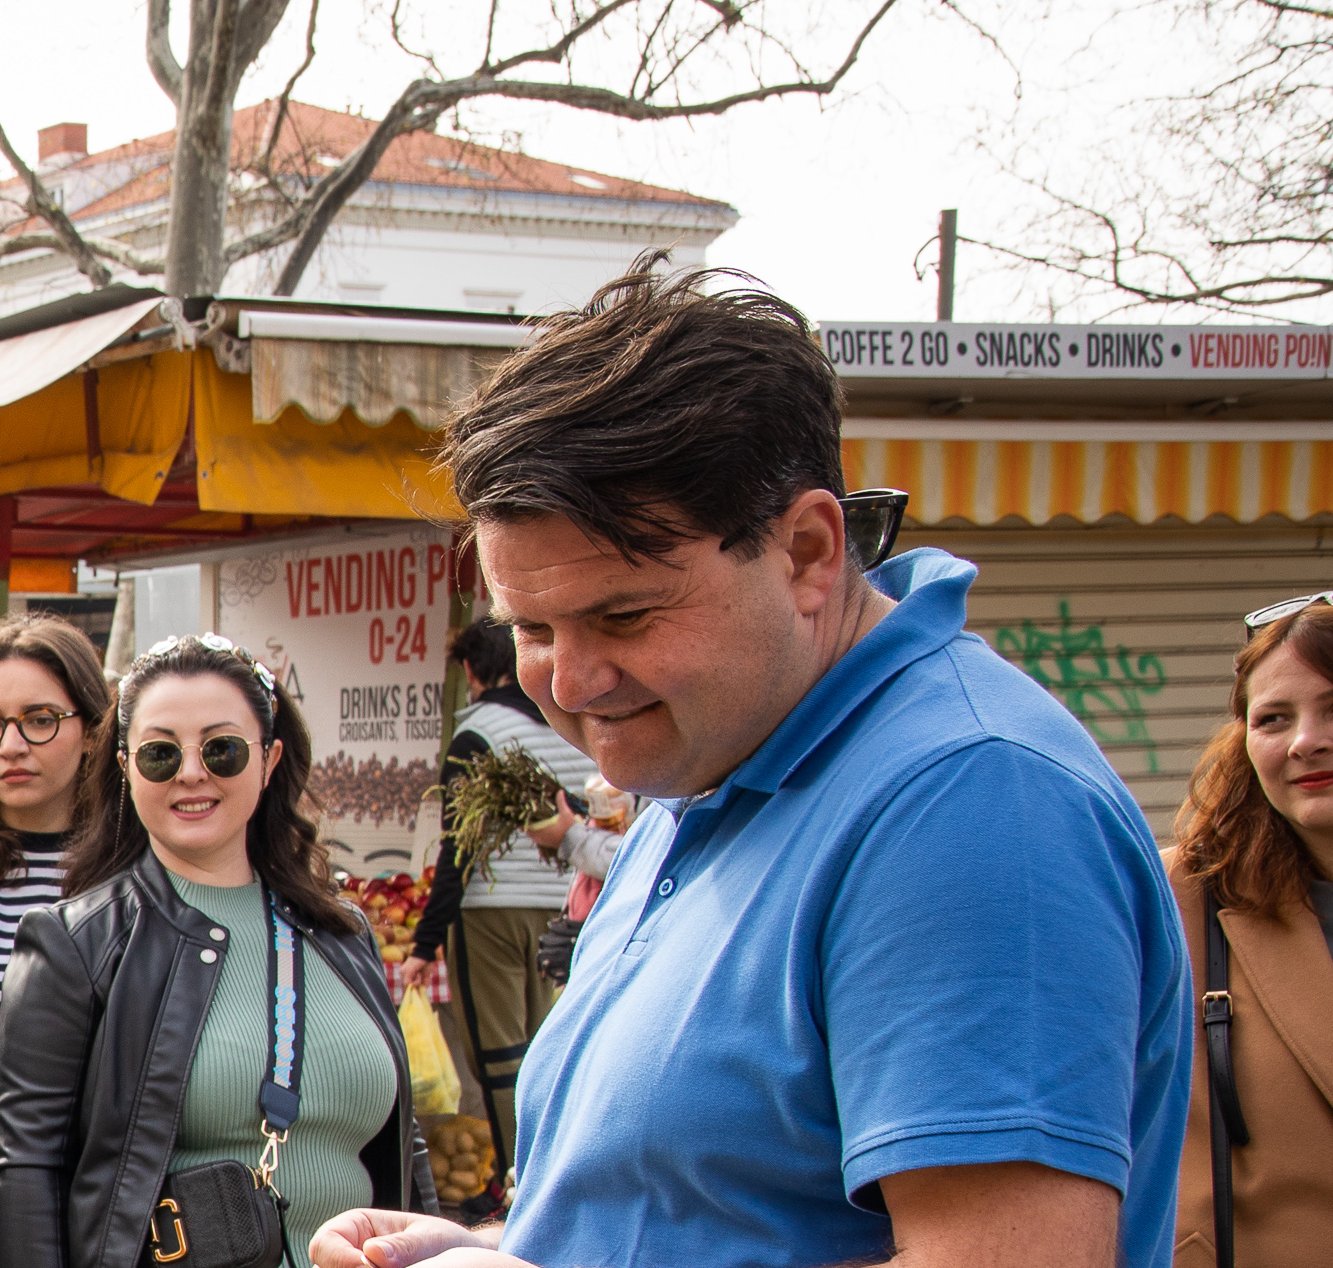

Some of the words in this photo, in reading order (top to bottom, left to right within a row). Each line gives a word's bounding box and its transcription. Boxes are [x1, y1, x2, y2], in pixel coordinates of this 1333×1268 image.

[826, 329, 894, 367] COFFE
[900, 330, 914, 367] 2
[920, 330, 949, 367] GO
[975, 331, 1061, 368] SNACKS
[1086, 332, 1165, 369] DRINKS
[1189, 332, 1279, 369] VENDING
[1283, 332, 1333, 369] PO!N
[285, 545, 417, 619] VENDING
[368, 614, 427, 665] 0-24
[340, 684, 401, 719] DRINKS
[406, 683, 418, 717] &
